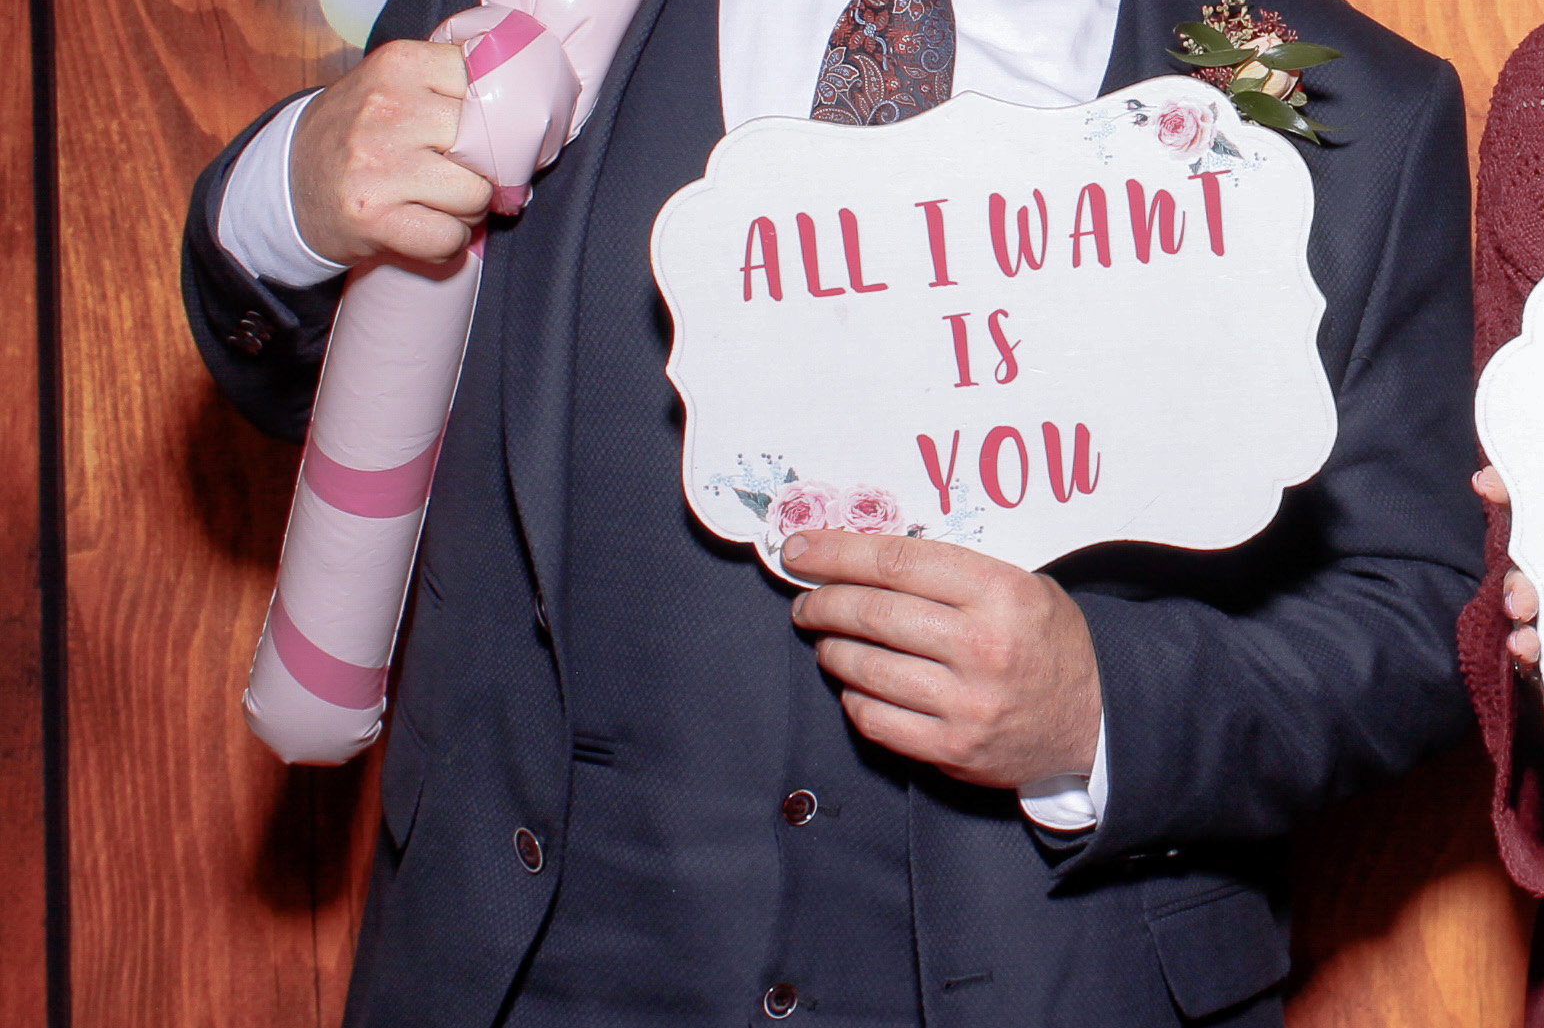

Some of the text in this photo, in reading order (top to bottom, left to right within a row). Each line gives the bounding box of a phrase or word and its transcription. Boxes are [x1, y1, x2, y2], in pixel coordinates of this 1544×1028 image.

[739, 207, 889, 302] ALL
[914, 198, 959, 288] I
[941, 308, 1022, 388] IS
[915, 420, 1101, 516] YOU
